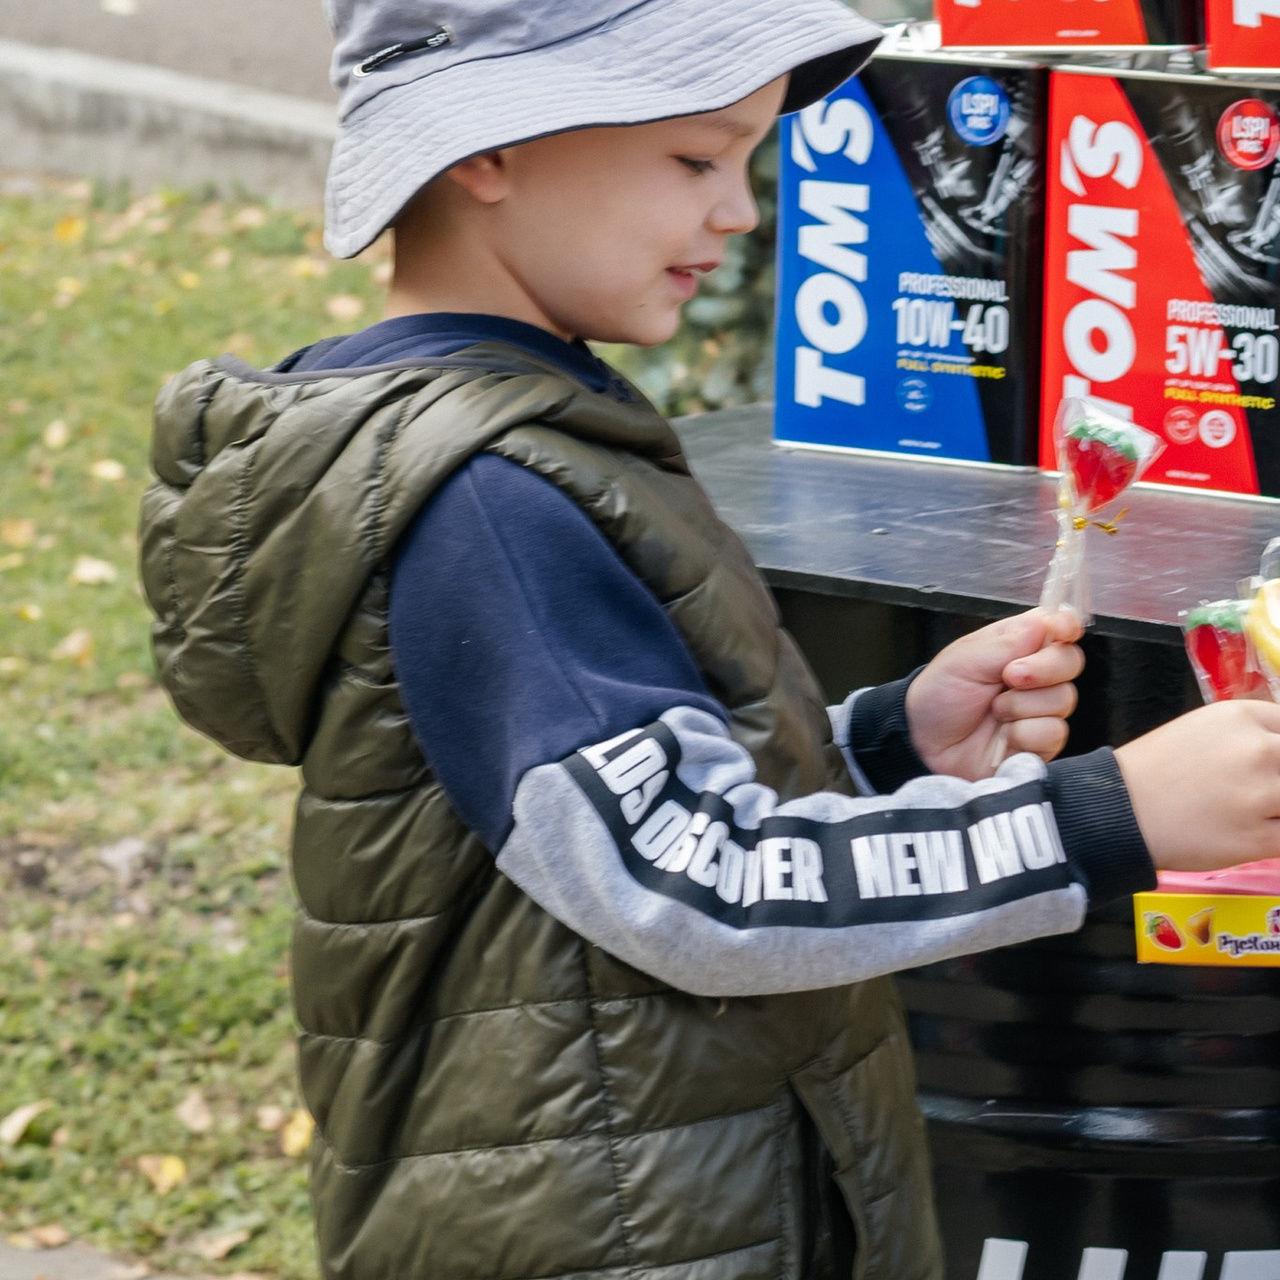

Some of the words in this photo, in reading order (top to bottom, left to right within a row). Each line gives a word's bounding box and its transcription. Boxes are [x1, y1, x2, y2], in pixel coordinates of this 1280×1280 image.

[791, 98, 874, 408] TOM'S
[898, 272, 1009, 302] PROFESSIONAL
[1166, 299, 1279, 331] PROFESSIONAL
[892, 297, 1010, 355] 10W-40
[1164, 325, 1279, 384] 5W-30
[850, 829, 969, 899] NEW
